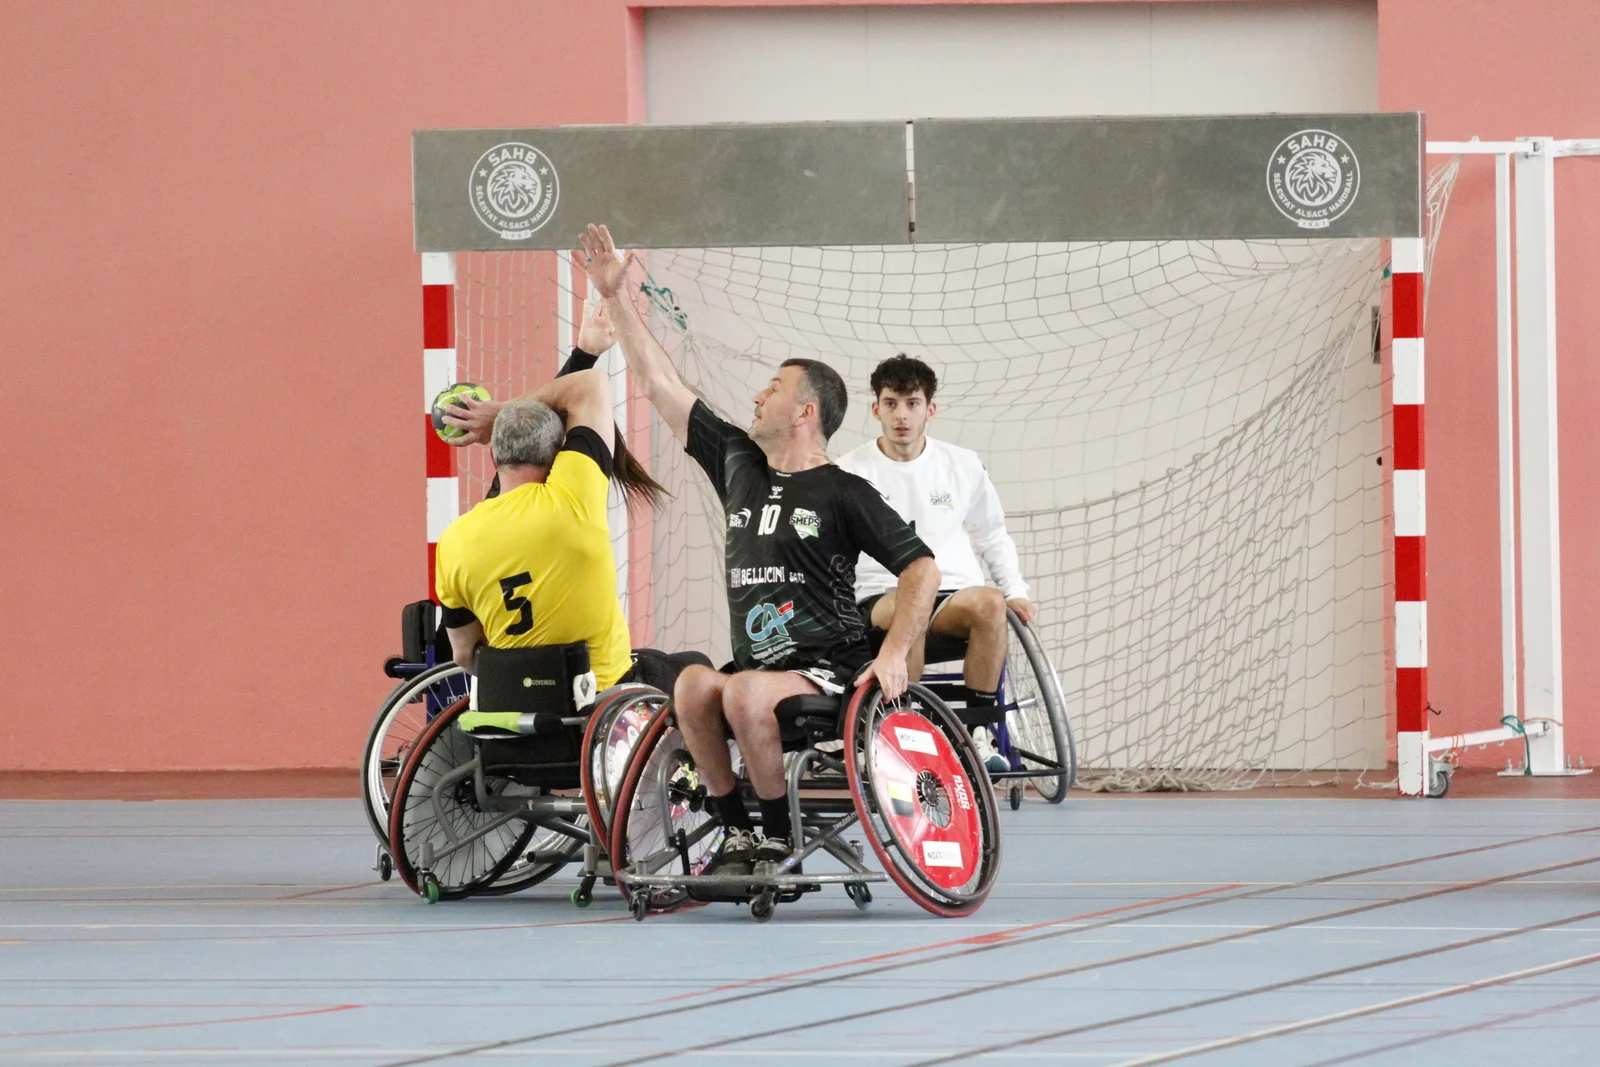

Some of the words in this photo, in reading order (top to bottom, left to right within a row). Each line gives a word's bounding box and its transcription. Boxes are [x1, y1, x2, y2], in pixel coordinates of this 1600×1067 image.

[488, 147, 537, 167] SAHB
[1287, 134, 1338, 154] SAHB
[498, 219, 530, 229] ALSACE
[530, 182, 552, 224] HANDBALL
[1295, 208, 1329, 218] ALSACE
[1329, 170, 1353, 213] HANDBALL
[757, 504, 781, 536] 10
[789, 515, 821, 527] SMEPS
[741, 566, 785, 586] BELLICINI
[499, 571, 534, 636] 5
